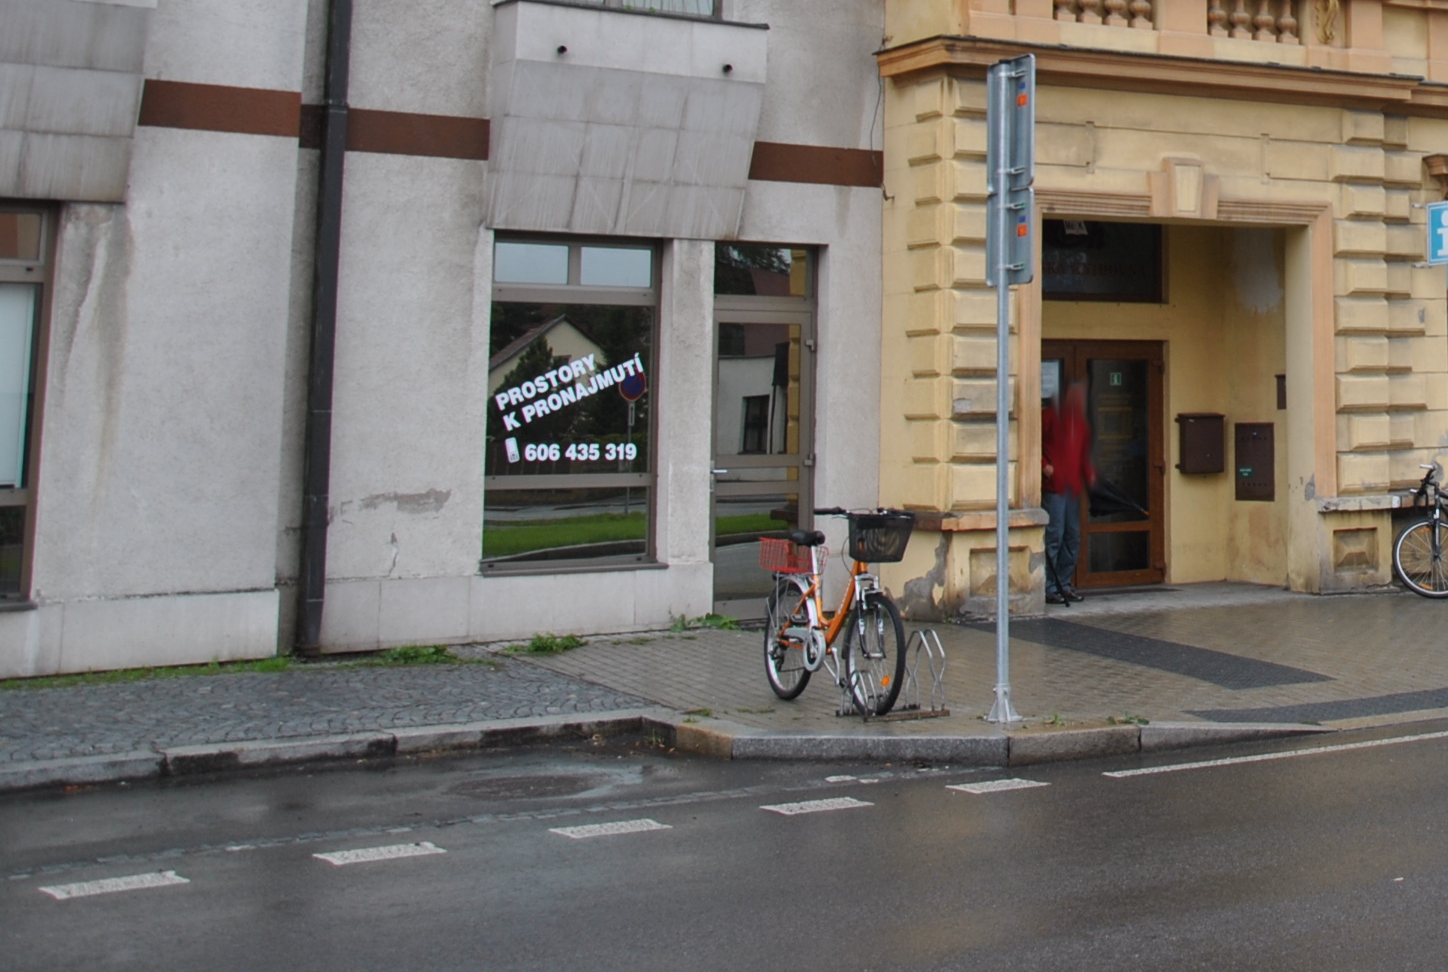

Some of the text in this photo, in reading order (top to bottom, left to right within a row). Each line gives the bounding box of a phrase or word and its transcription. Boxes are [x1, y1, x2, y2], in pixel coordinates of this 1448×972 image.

[495, 354, 596, 411] PROSTORY
[503, 352, 644, 431] K PRONAJMUTÍ
[525, 443, 637, 461] 606 435 319
